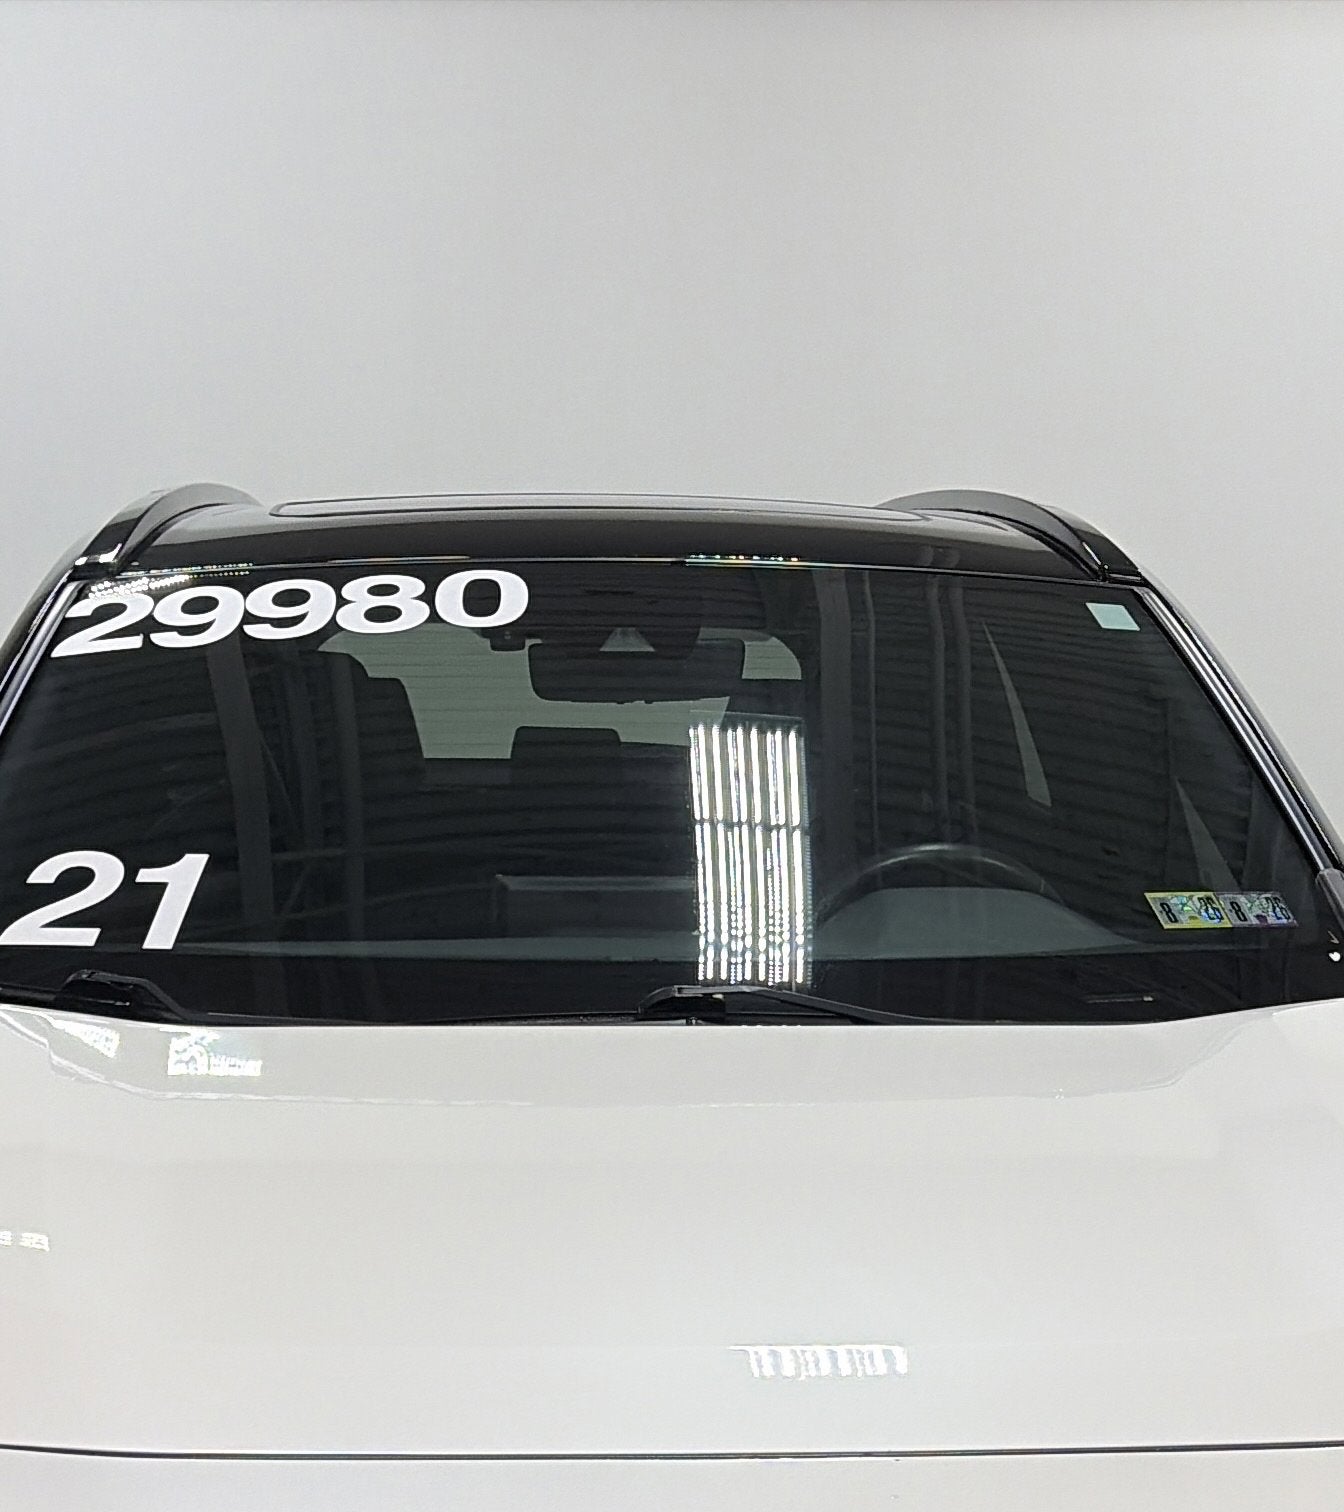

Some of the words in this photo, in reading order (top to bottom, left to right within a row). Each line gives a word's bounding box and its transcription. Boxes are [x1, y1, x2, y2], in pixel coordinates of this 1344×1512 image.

[50, 569, 529, 658] 29980
[1160, 902, 1178, 923] 8
[1230, 901, 1248, 922] 8
